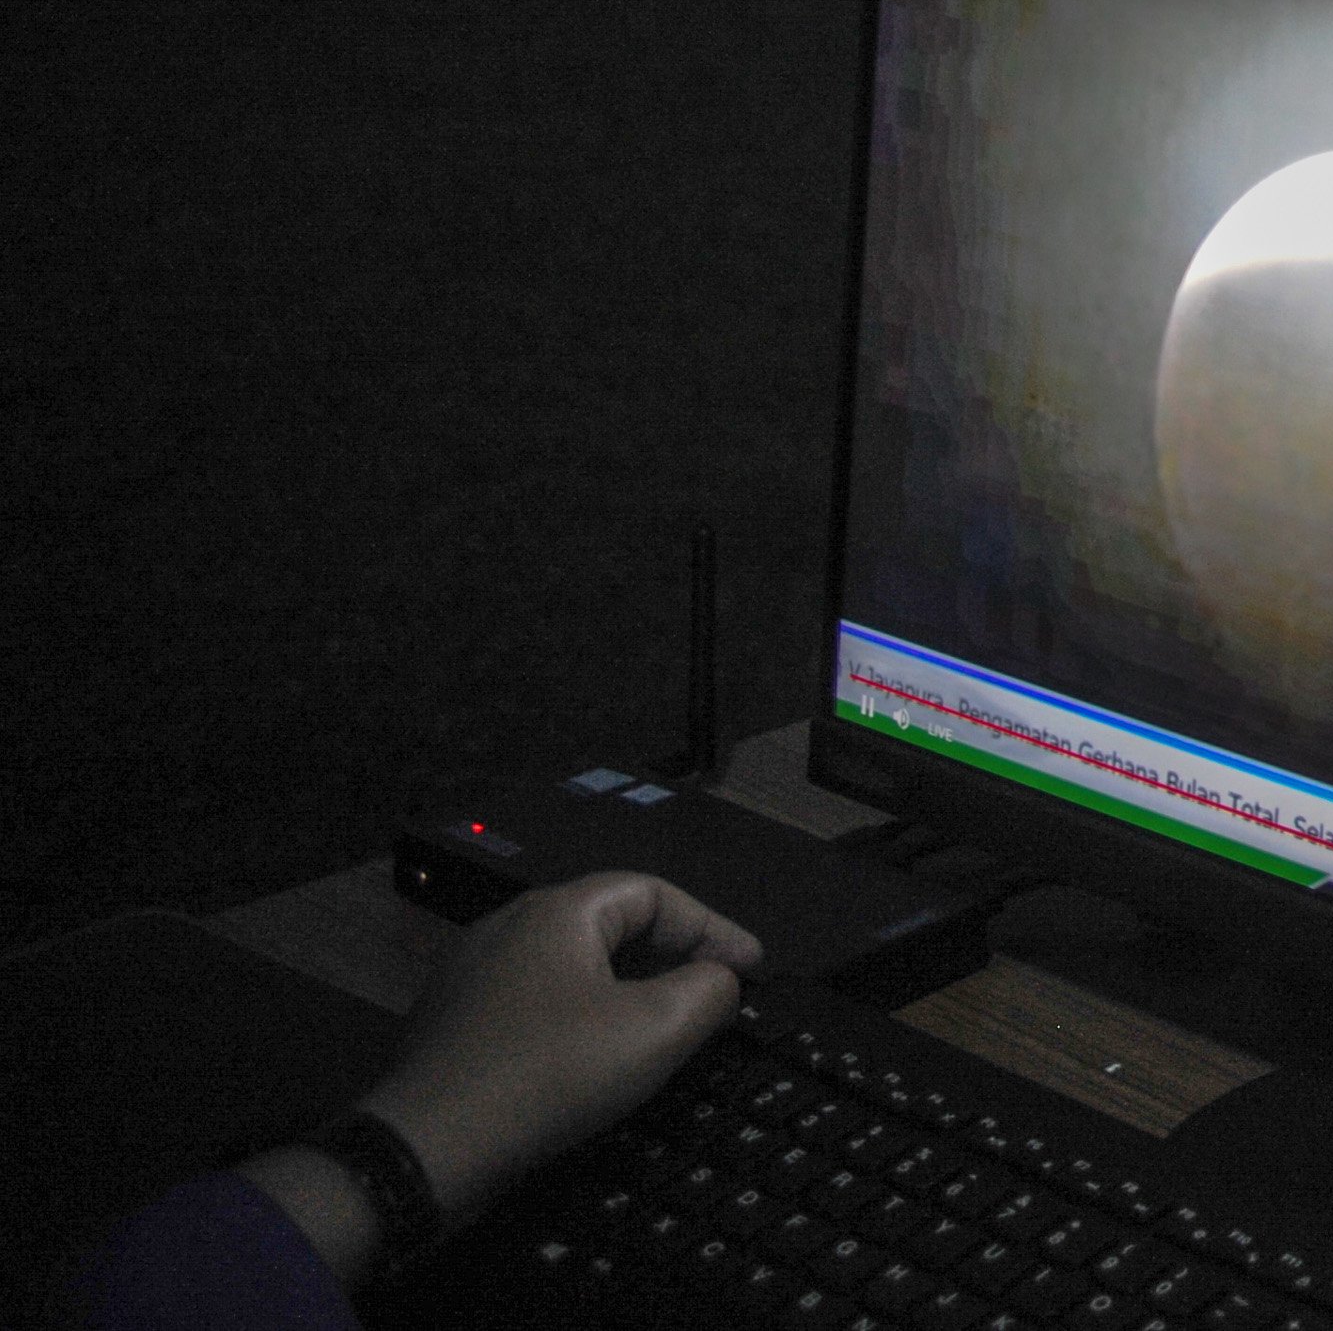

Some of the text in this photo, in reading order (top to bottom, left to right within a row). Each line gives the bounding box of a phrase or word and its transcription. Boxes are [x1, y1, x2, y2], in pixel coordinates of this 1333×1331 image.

[927, 722, 953, 743] LIVE
[958, 697, 1072, 758] Pengamatan
[1079, 741, 1159, 789] Gerhana
[1166, 771, 1221, 812] Bulan
[691, 1168, 712, 1182] S
[937, 1293, 957, 1305] J
[702, 1242, 724, 1257] C
[740, 1127, 763, 1142] W
[784, 1149, 805, 1164] E
[885, 1196, 903, 1210] T
[936, 1220, 954, 1233] Y
[983, 1244, 1005, 1260] U
[1090, 1295, 1112, 1312] O
